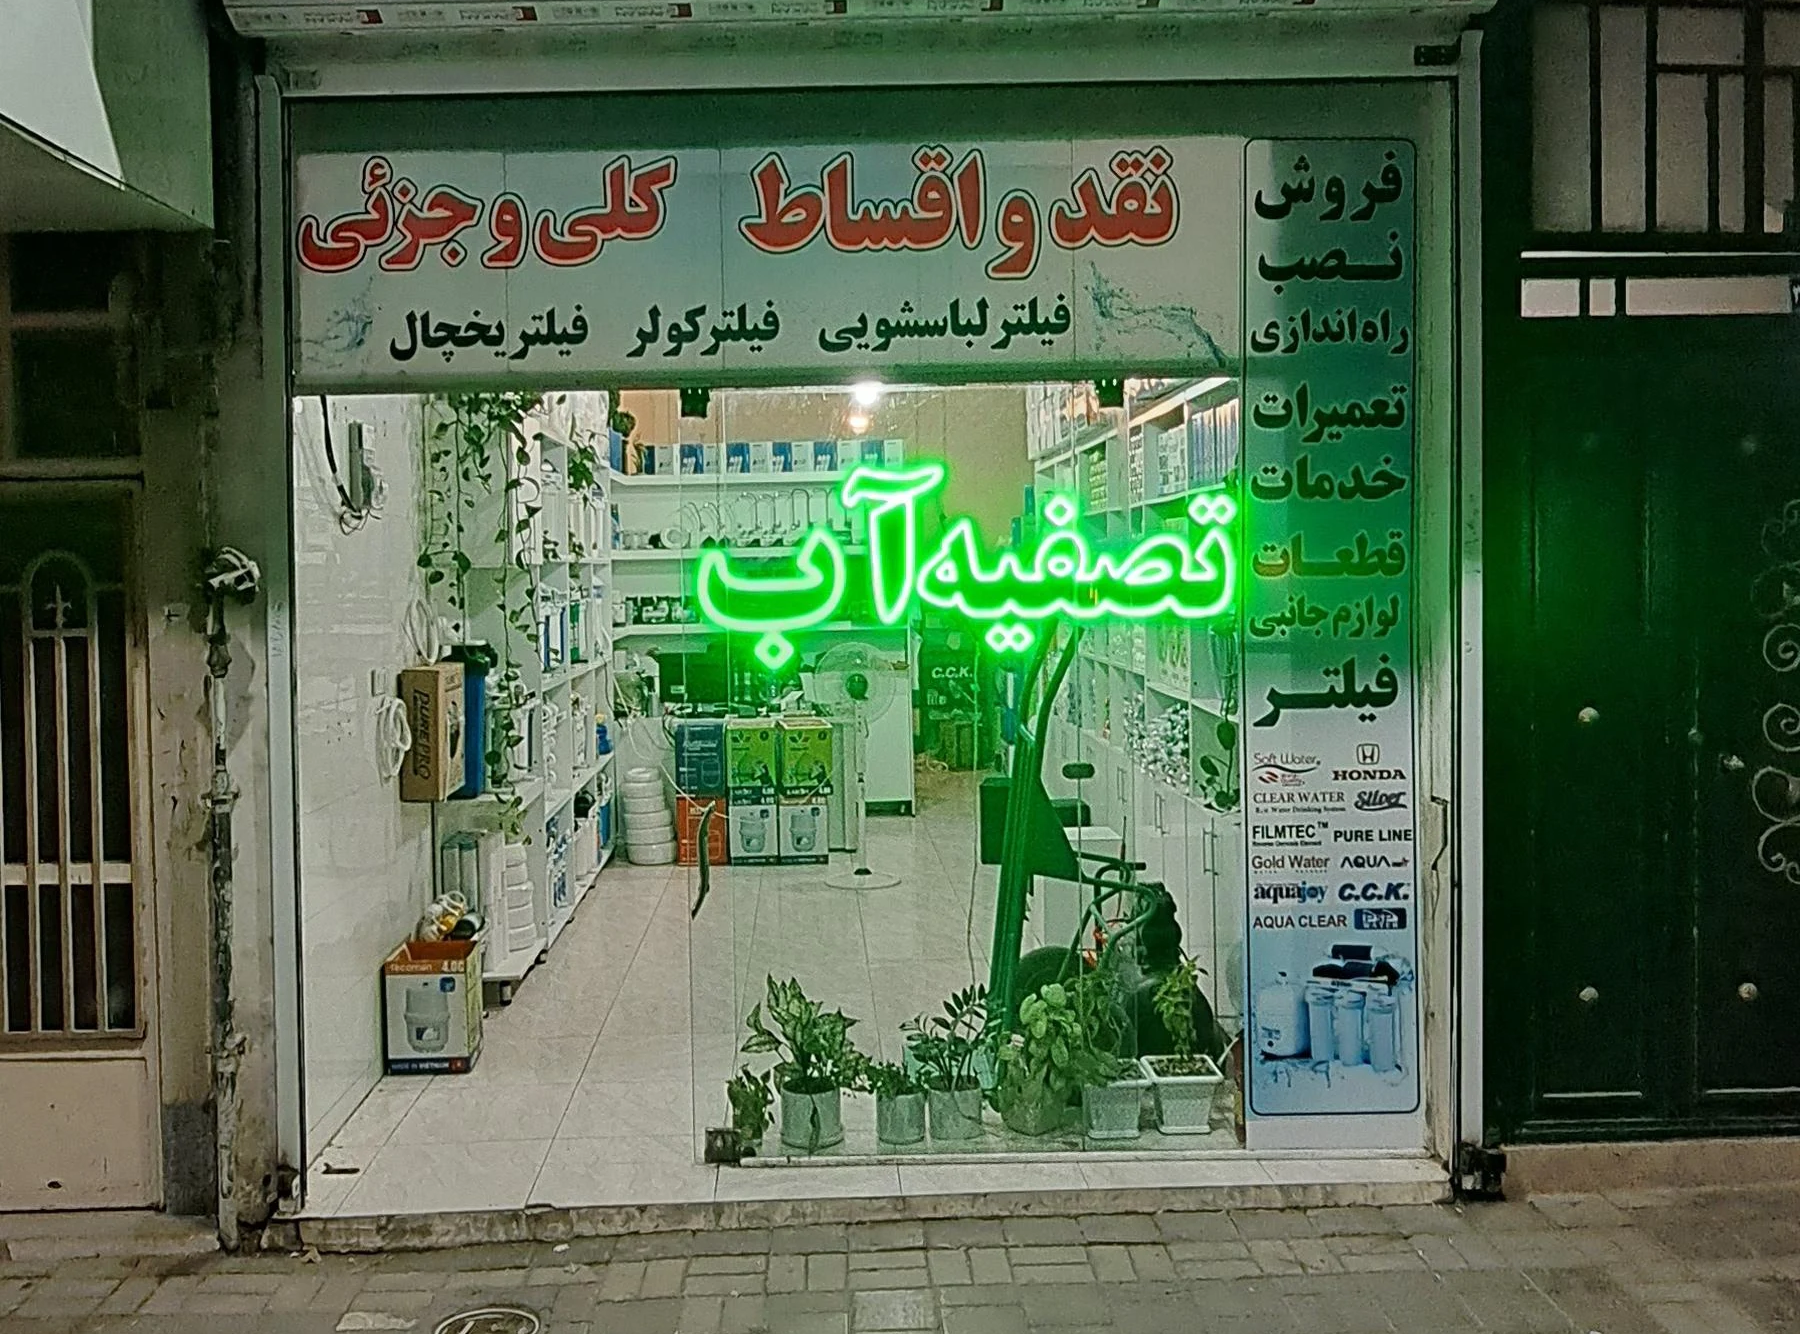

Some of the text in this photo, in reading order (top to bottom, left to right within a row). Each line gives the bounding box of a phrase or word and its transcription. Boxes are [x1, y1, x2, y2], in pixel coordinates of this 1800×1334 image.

[1254, 149, 1404, 222] فروش
[297, 144, 1180, 280] نقد و اقساط کلی و جزئی
[1257, 230, 1404, 295] نصب
[389, 307, 508, 364] یخچال
[509, 304, 591, 361] فیلتر
[626, 304, 707, 358] کولر
[700, 300, 780, 357] فیلتر
[990, 293, 1072, 351] فیلتر
[1252, 381, 1408, 444] تعمیرات
[1250, 453, 1408, 502] خدمات
[695, 464, 1237, 670] تصفیه آب
[1252, 529, 1406, 578] قطعات
[1250, 594, 1400, 638] لوازم جانبی
[1252, 652, 1400, 728] فیلتر
[1253, 752, 1277, 765] Soft
[1332, 769, 1407, 781] HONDA
[1253, 791, 1346, 804] CLEAR WATER
[1252, 824, 1317, 839] FILMTEC
[1333, 829, 1413, 843] PURE LINE
[1251, 854, 1331, 869] Gold Water
[1253, 880, 1329, 904] aquajoy
[1338, 882, 1410, 901] C.C.K.
[1252, 915, 1296, 929] AQUA
[1298, 914, 1348, 928] CLEAR
